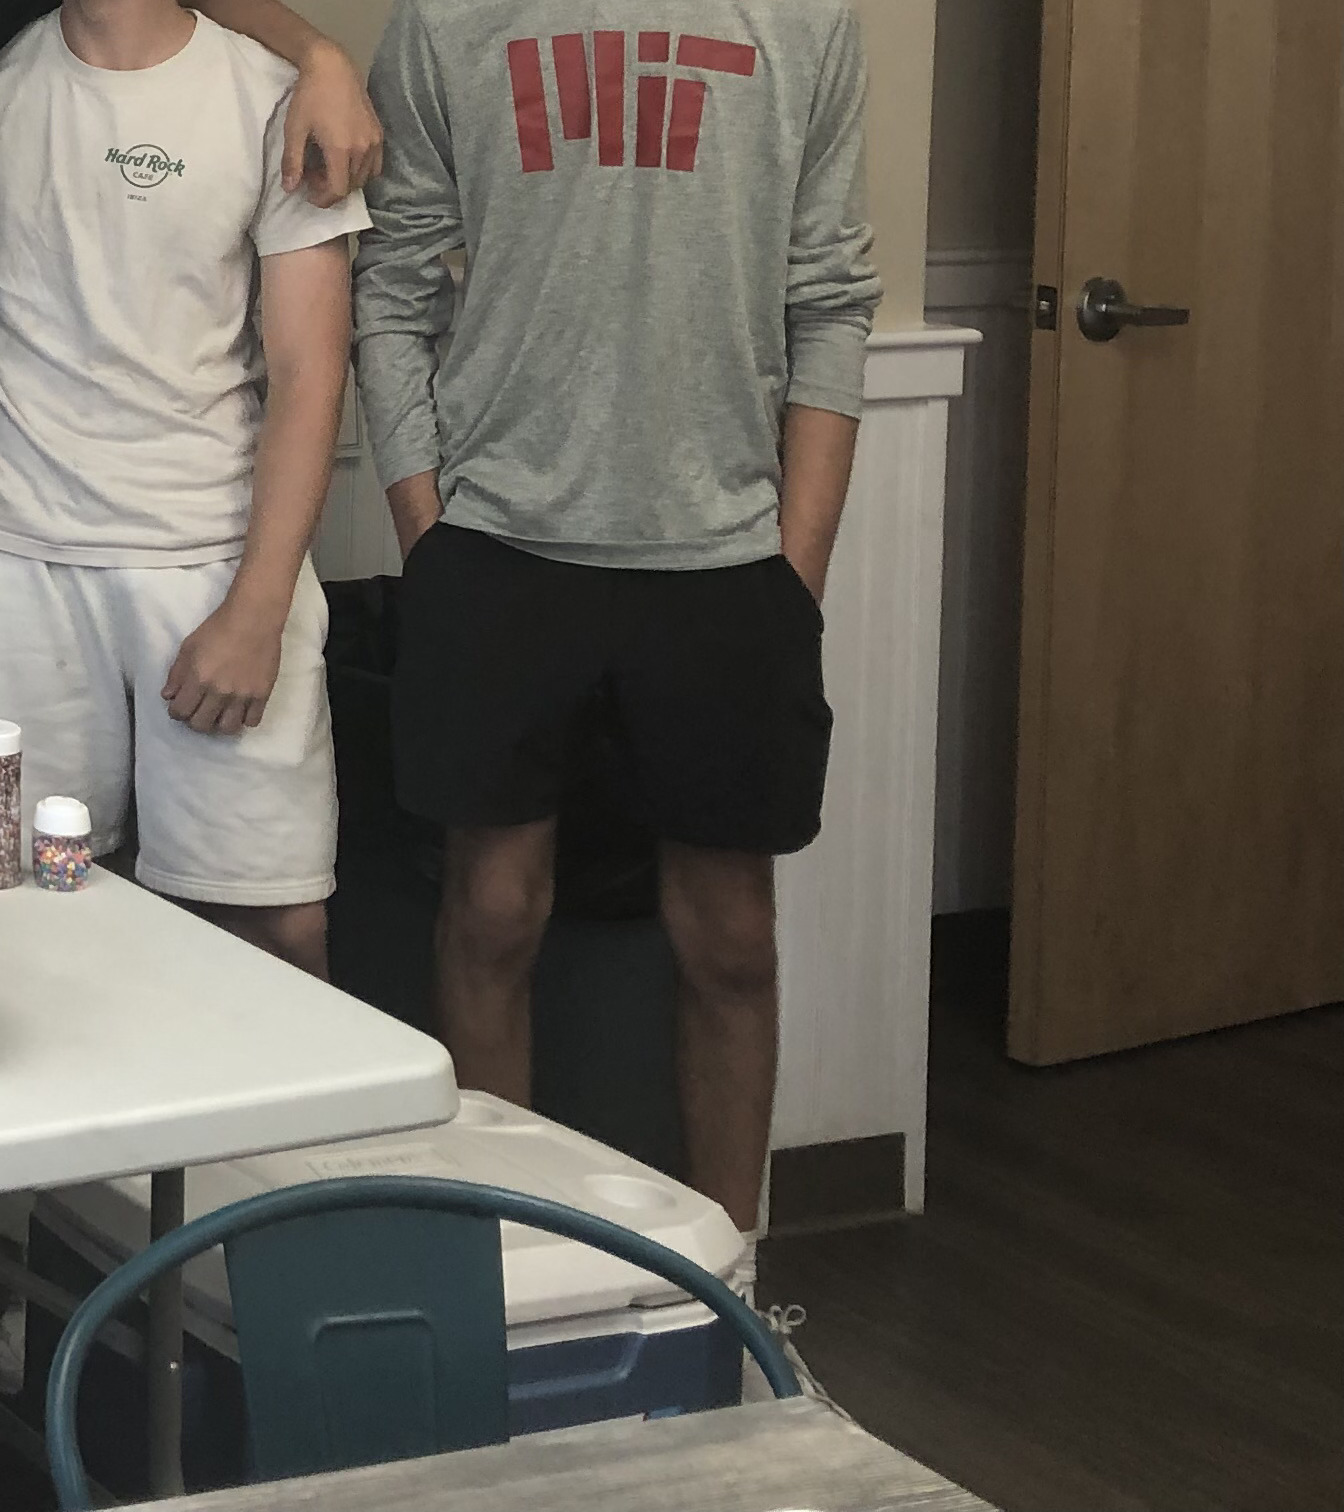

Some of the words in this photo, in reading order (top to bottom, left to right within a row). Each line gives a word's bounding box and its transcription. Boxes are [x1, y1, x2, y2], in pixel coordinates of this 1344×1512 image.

[105, 148, 147, 167] Hard
[147, 154, 185, 177] Rock
[132, 171, 154, 181] CAFE
